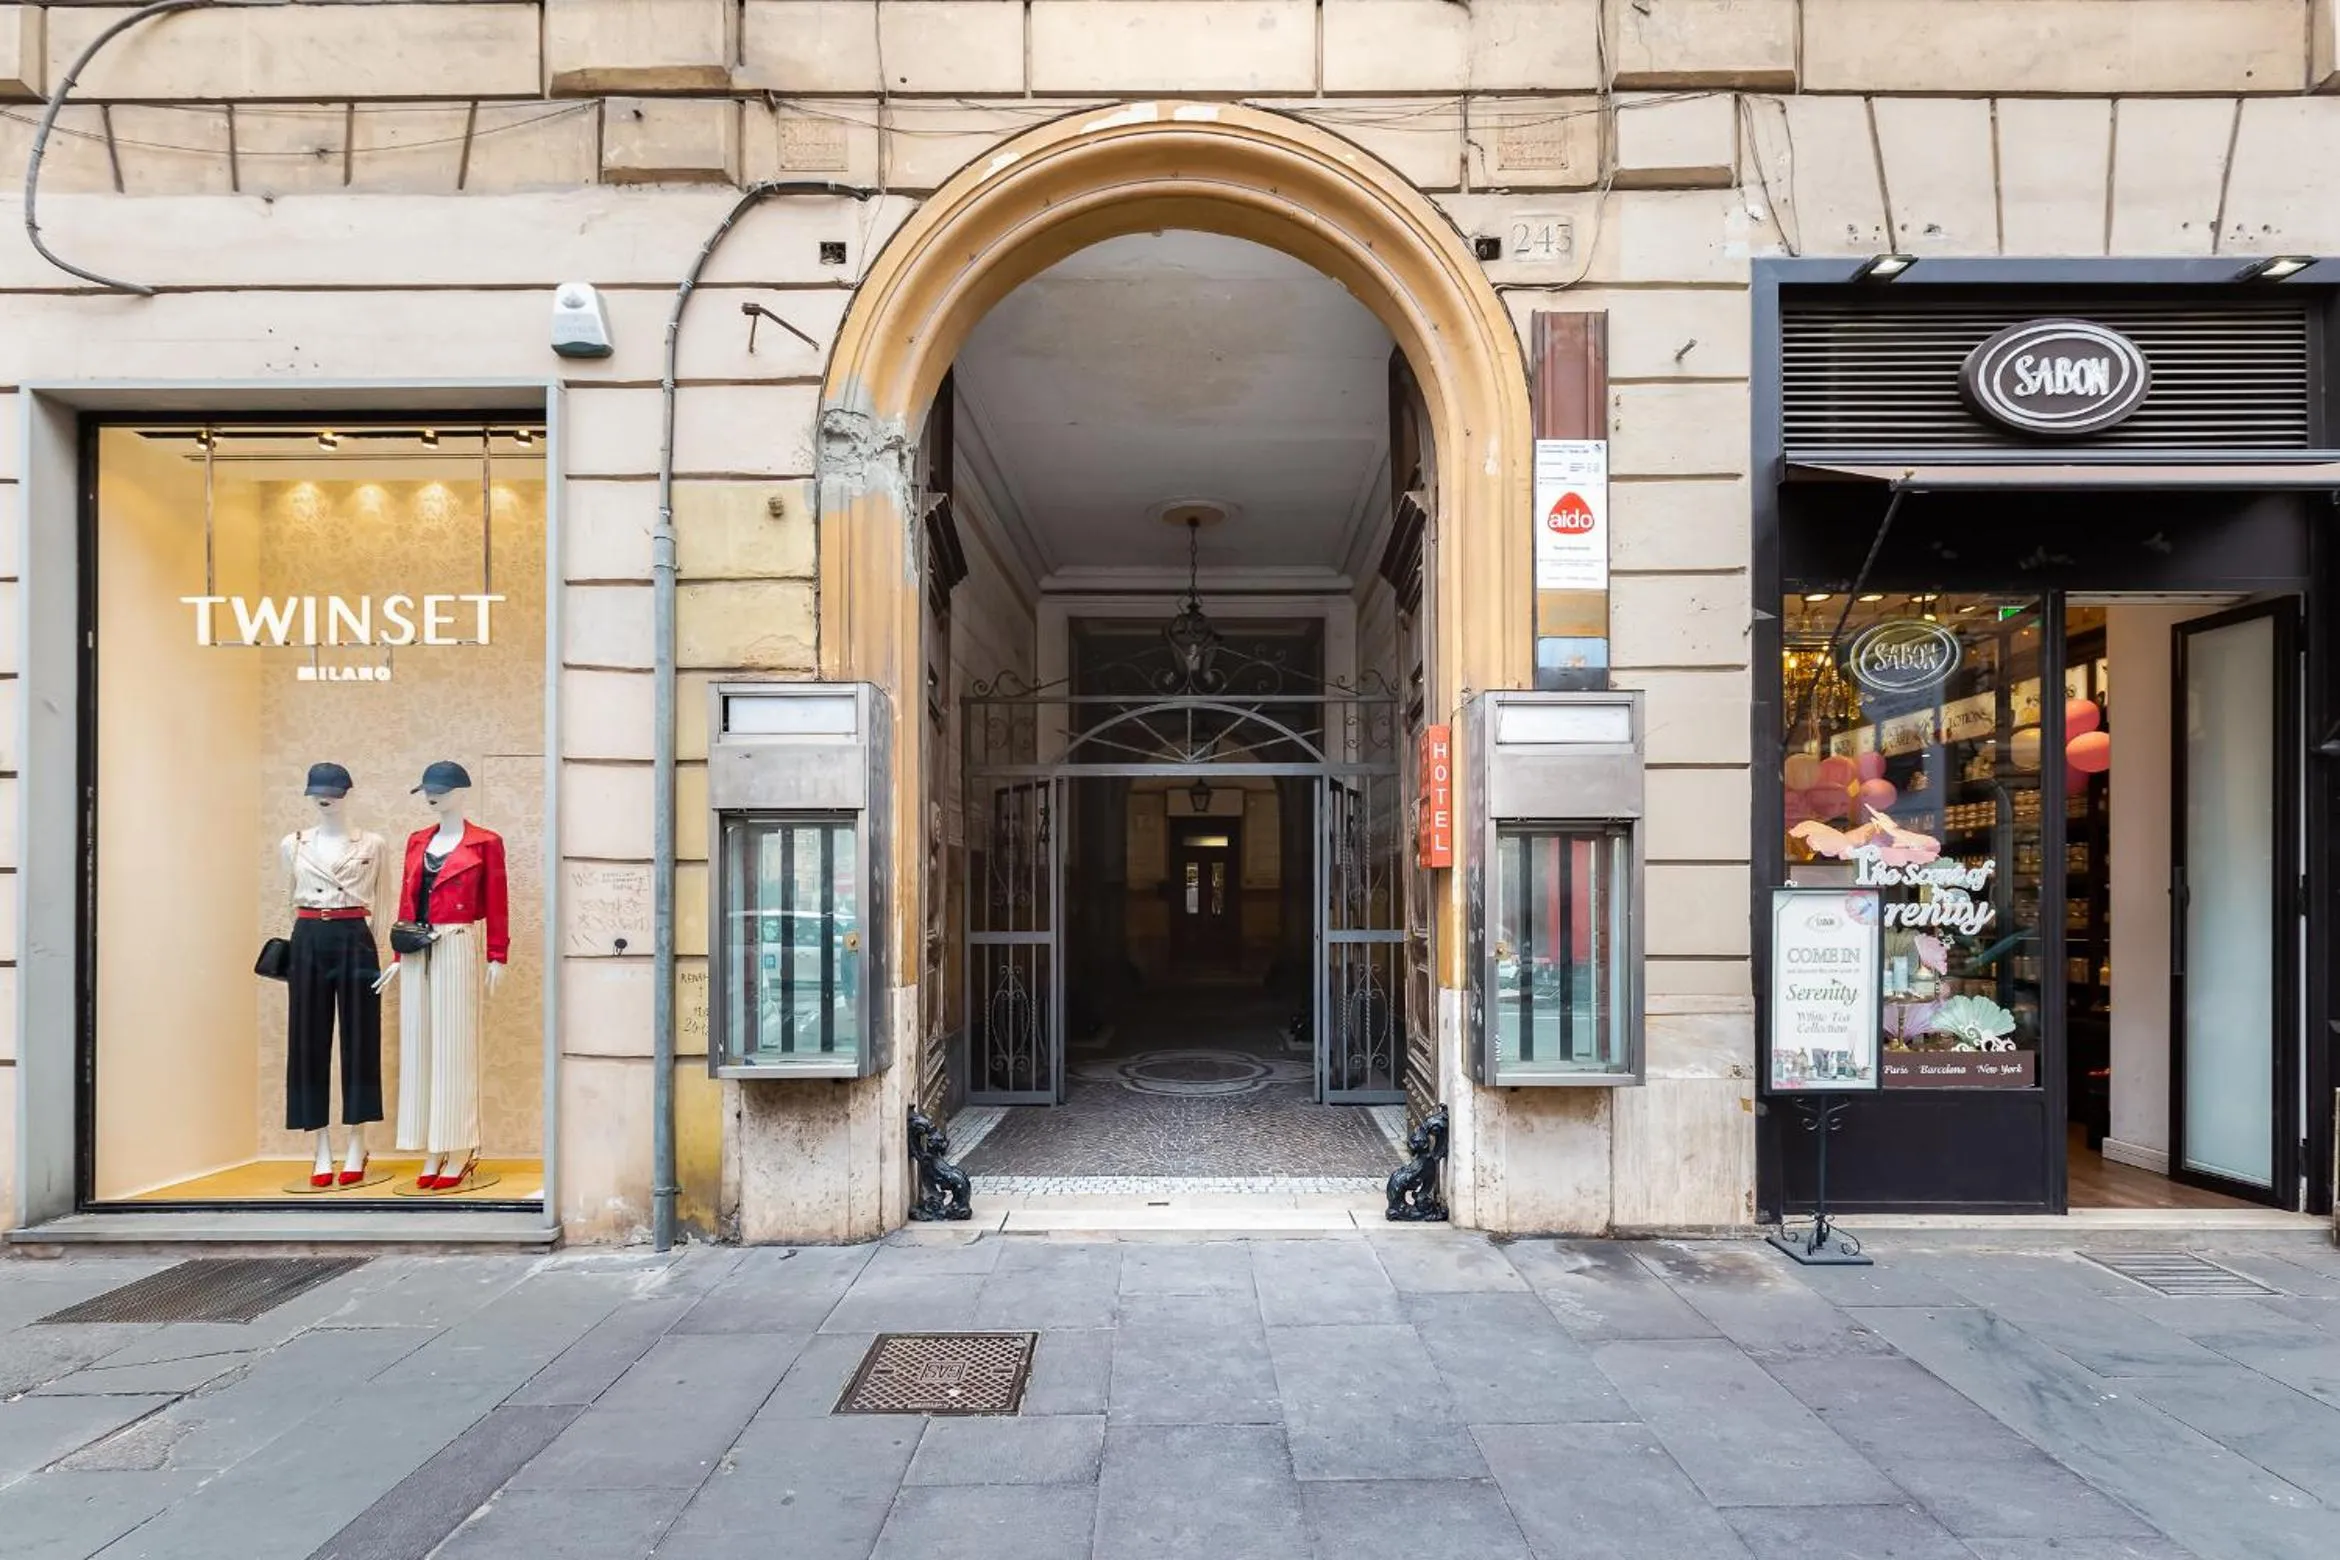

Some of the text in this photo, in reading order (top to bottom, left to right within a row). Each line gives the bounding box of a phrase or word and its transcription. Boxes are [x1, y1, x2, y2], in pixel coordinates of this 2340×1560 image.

[2013, 355, 2110, 397] SABON
[1548, 509, 1594, 529] aido
[180, 594, 506, 646] TWINSET
[1873, 642, 1938, 672] SABON
[297, 666, 392, 681] MILANO
[1432, 742, 1449, 851] HOTEL
[1884, 901, 1996, 936] renity
[1787, 948, 1860, 964] COME IN
[1785, 983, 1860, 1006] Serenity
[1884, 1064, 2023, 1076] Paris Barcelona New York
